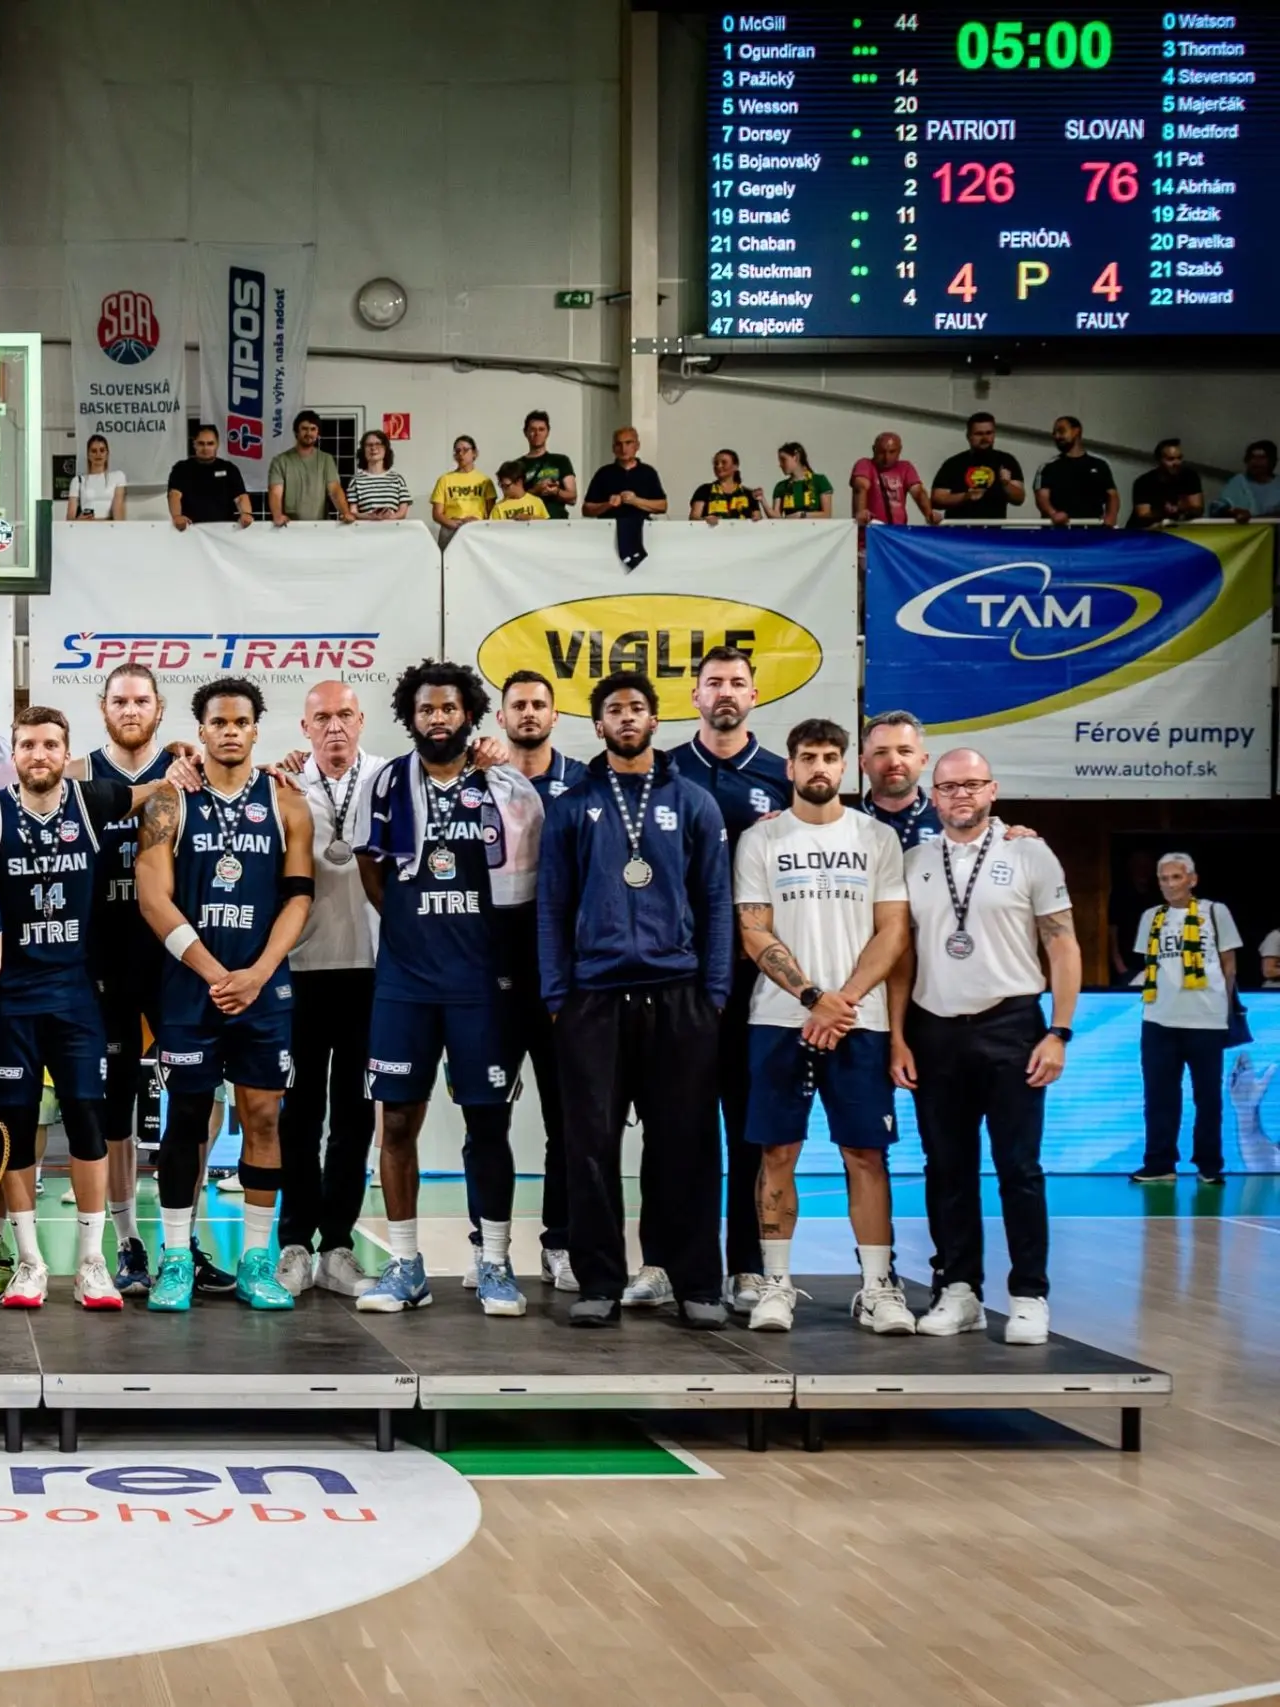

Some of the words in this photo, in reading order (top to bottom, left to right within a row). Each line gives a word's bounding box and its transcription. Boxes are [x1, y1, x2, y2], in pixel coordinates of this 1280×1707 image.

[723, 16, 734, 32] 0
[739, 15, 786, 31] McGill
[895, 14, 918, 31] 44
[1162, 12, 1176, 30] 0
[1178, 13, 1236, 29] Watson
[723, 43, 732, 60] 1
[739, 44, 815, 61] Ogundiran
[956, 20, 1112, 70] 05:00
[1162, 40, 1176, 58] 3
[1177, 41, 1245, 56] Thornton
[722, 71, 733, 87] 3
[896, 69, 918, 86] 14
[1162, 67, 1175, 85] 4
[1178, 68, 1256, 84] Stevenson
[722, 98, 733, 115] 5
[738, 99, 799, 114] Wesson
[894, 97, 918, 113] 20
[1162, 95, 1175, 112] 5
[722, 126, 733, 143] 7
[738, 127, 791, 144] Dorsey
[895, 124, 918, 141] 12
[926, 119, 1016, 141] PATRIOTI
[1065, 118, 1144, 140] SLOVAN
[1162, 123, 1175, 140] 8
[1177, 124, 1240, 139] Medford
[713, 153, 733, 170] 15
[738, 153, 821, 172] Bojanovský
[904, 152, 918, 168] 6
[1153, 150, 1173, 167] 11
[1176, 151, 1205, 166] Pot
[712, 180, 733, 197] 17
[738, 181, 796, 199] Gergely
[904, 179, 918, 196] 2
[932, 161, 1016, 204] 126
[1080, 161, 1139, 204] 76
[1152, 178, 1174, 195] 14
[1176, 179, 1237, 194] Abrhám
[712, 208, 733, 225] 19
[896, 206, 915, 223] 11
[1152, 206, 1174, 222] 19
[711, 236, 731, 252] 21
[738, 236, 796, 251] Chaban
[903, 234, 917, 251] 2
[999, 228, 1071, 248] PERIÓDA
[1150, 233, 1174, 250] 20
[1176, 234, 1236, 249] Pavelka
[711, 263, 733, 279] 24
[738, 263, 812, 279] Stuckman
[896, 262, 915, 278] 11
[1150, 261, 1172, 278] 21
[947, 262, 978, 303] 4
[1017, 261, 1050, 300] P
[1091, 262, 1123, 303] 4
[711, 290, 732, 307] 31
[903, 289, 917, 306] 4
[1150, 288, 1173, 305] 22
[1176, 289, 1234, 304] Howard
[103, 294, 153, 343] SBA
[711, 318, 733, 334] 47
[738, 318, 804, 335] Krajčovič
[934, 312, 988, 329] FAULY
[1076, 312, 1130, 329] FAULY
[232, 277, 261, 405] TIPOS
[89, 378, 170, 397] SLOVENSKÁ
[79, 396, 180, 415] BASKETBALOVÁ
[95, 415, 167, 433] ASOCIÁCIA
[966, 594, 1092, 629] TAM
[270, 673, 305, 684] FIRMA
[1075, 721, 1161, 744] Férové
[1169, 725, 1255, 748] pumpy
[1075, 759, 1217, 777] www.autohof.sk
[777, 850, 868, 873] SLOVAN
[30, 882, 66, 911] 14
[106, 879, 138, 902] JT
[782, 889, 864, 902] BASKETBALL
[417, 890, 480, 916] JTRE
[197, 902, 255, 929] JTRE
[18, 919, 80, 946] JTRE
[171, 1053, 201, 1064] TIPOS
[377, 1062, 409, 1074] TIPOS
